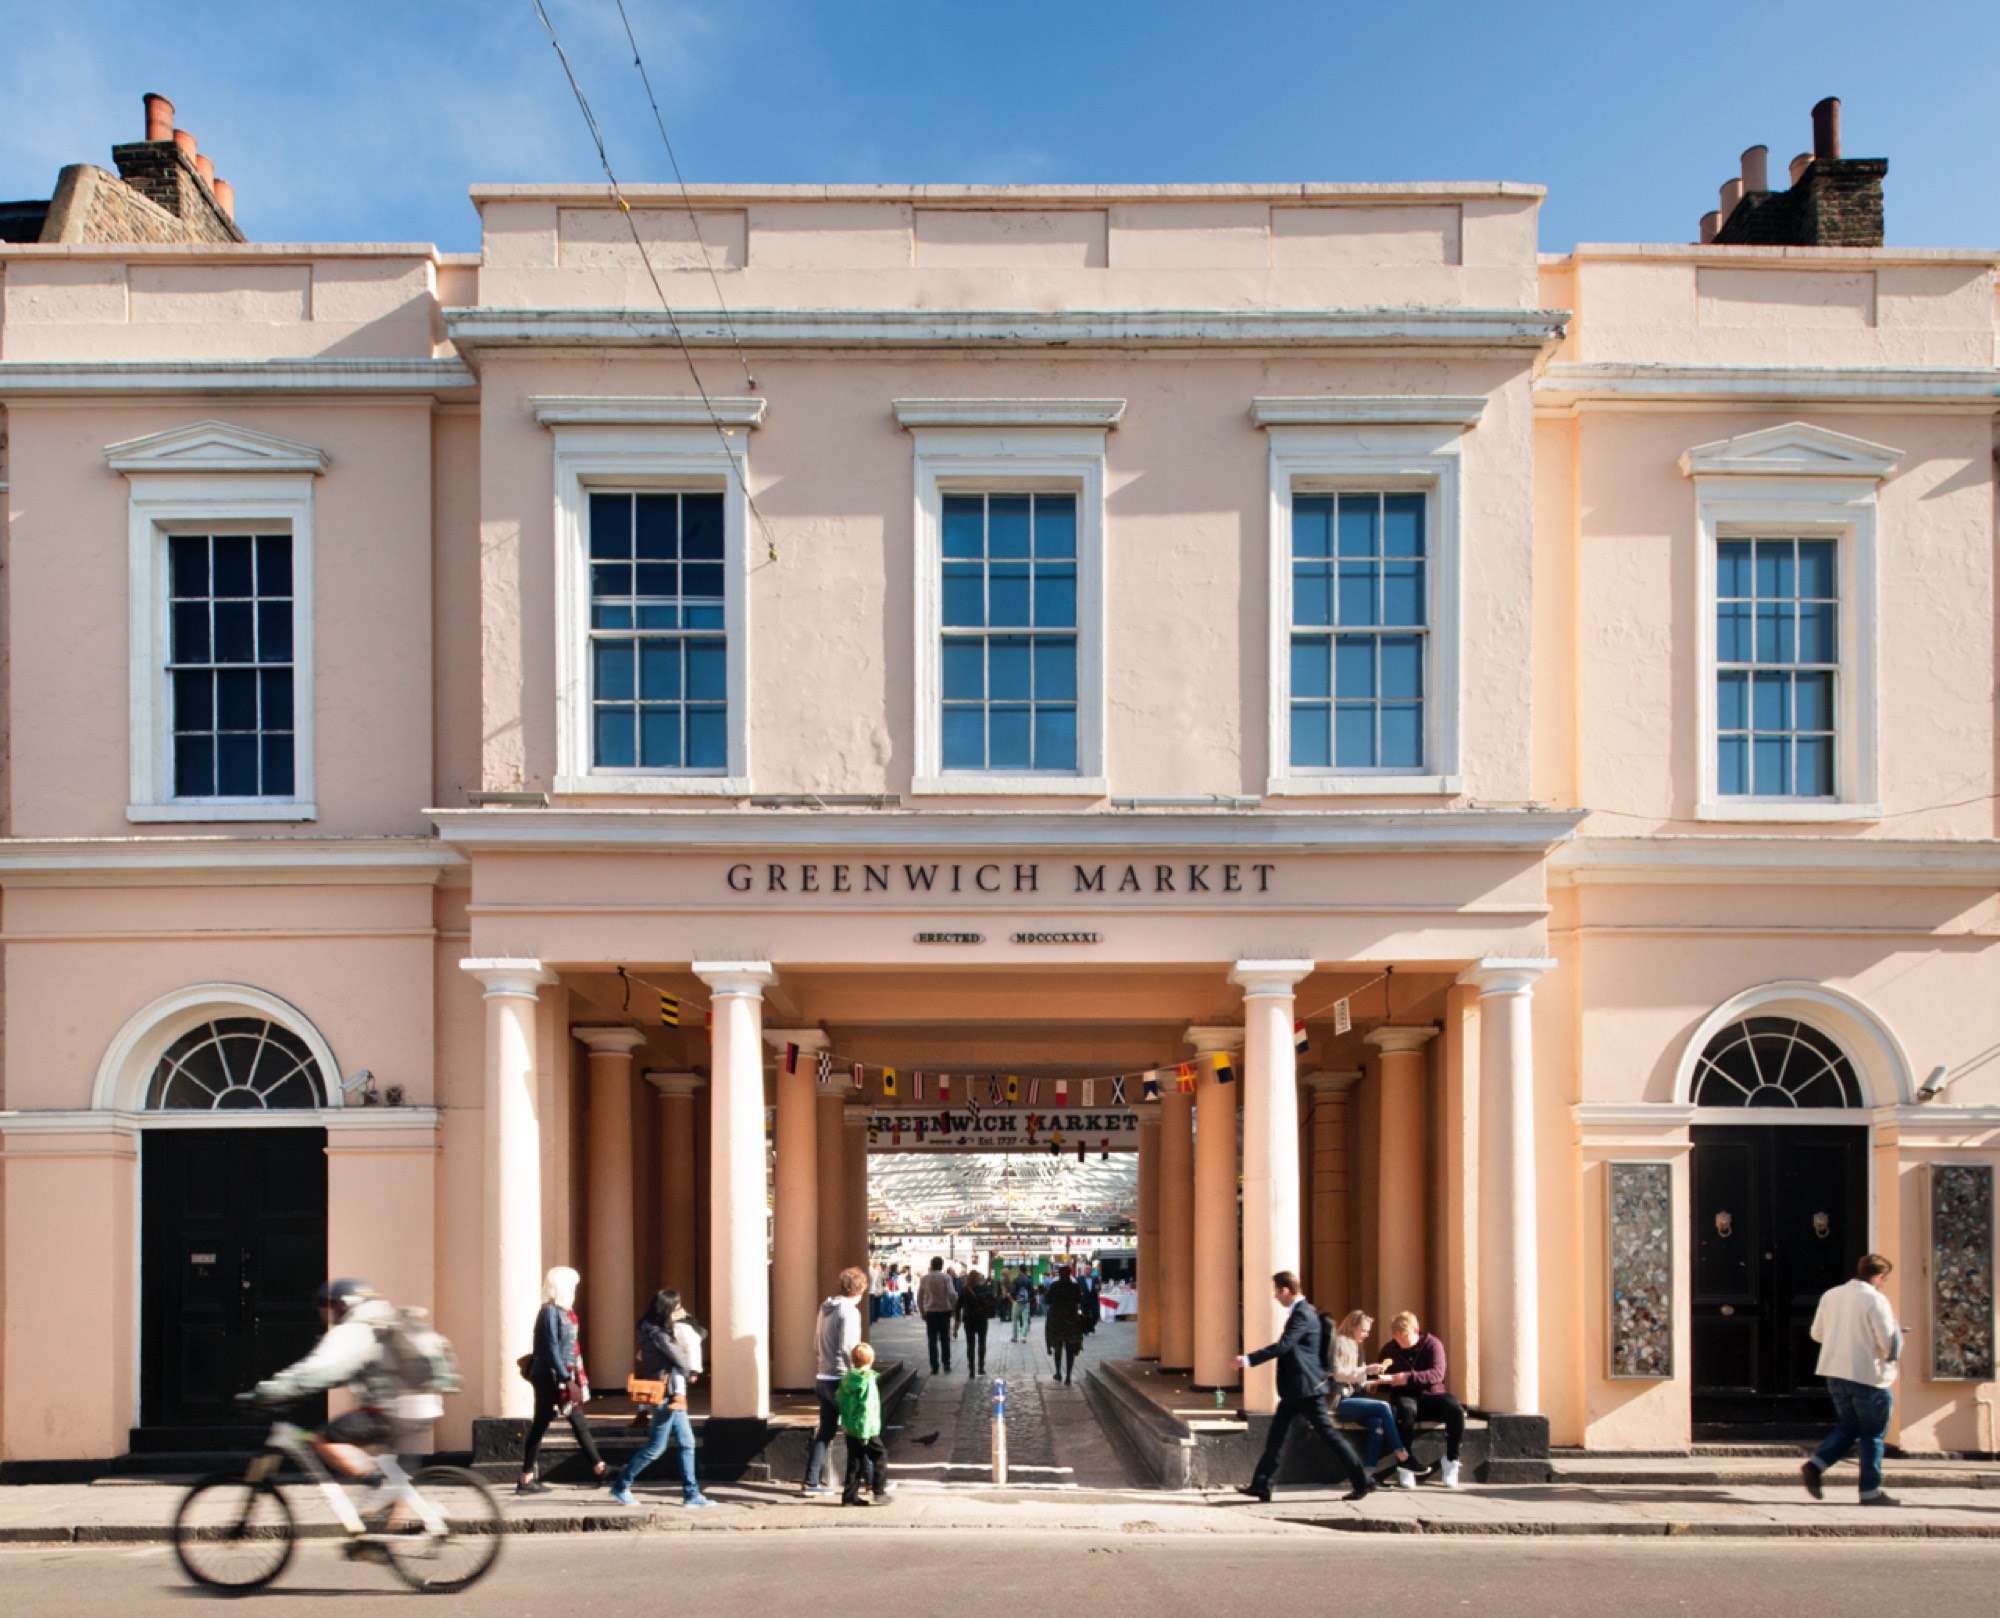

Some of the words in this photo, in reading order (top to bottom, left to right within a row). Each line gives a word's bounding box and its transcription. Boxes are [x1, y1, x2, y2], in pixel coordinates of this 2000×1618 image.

[726, 863, 1039, 893] GREENWICH
[1073, 864, 1276, 893] MARKET
[918, 932, 981, 944] ERECTED
[866, 1115, 1017, 1132] REENWICH
